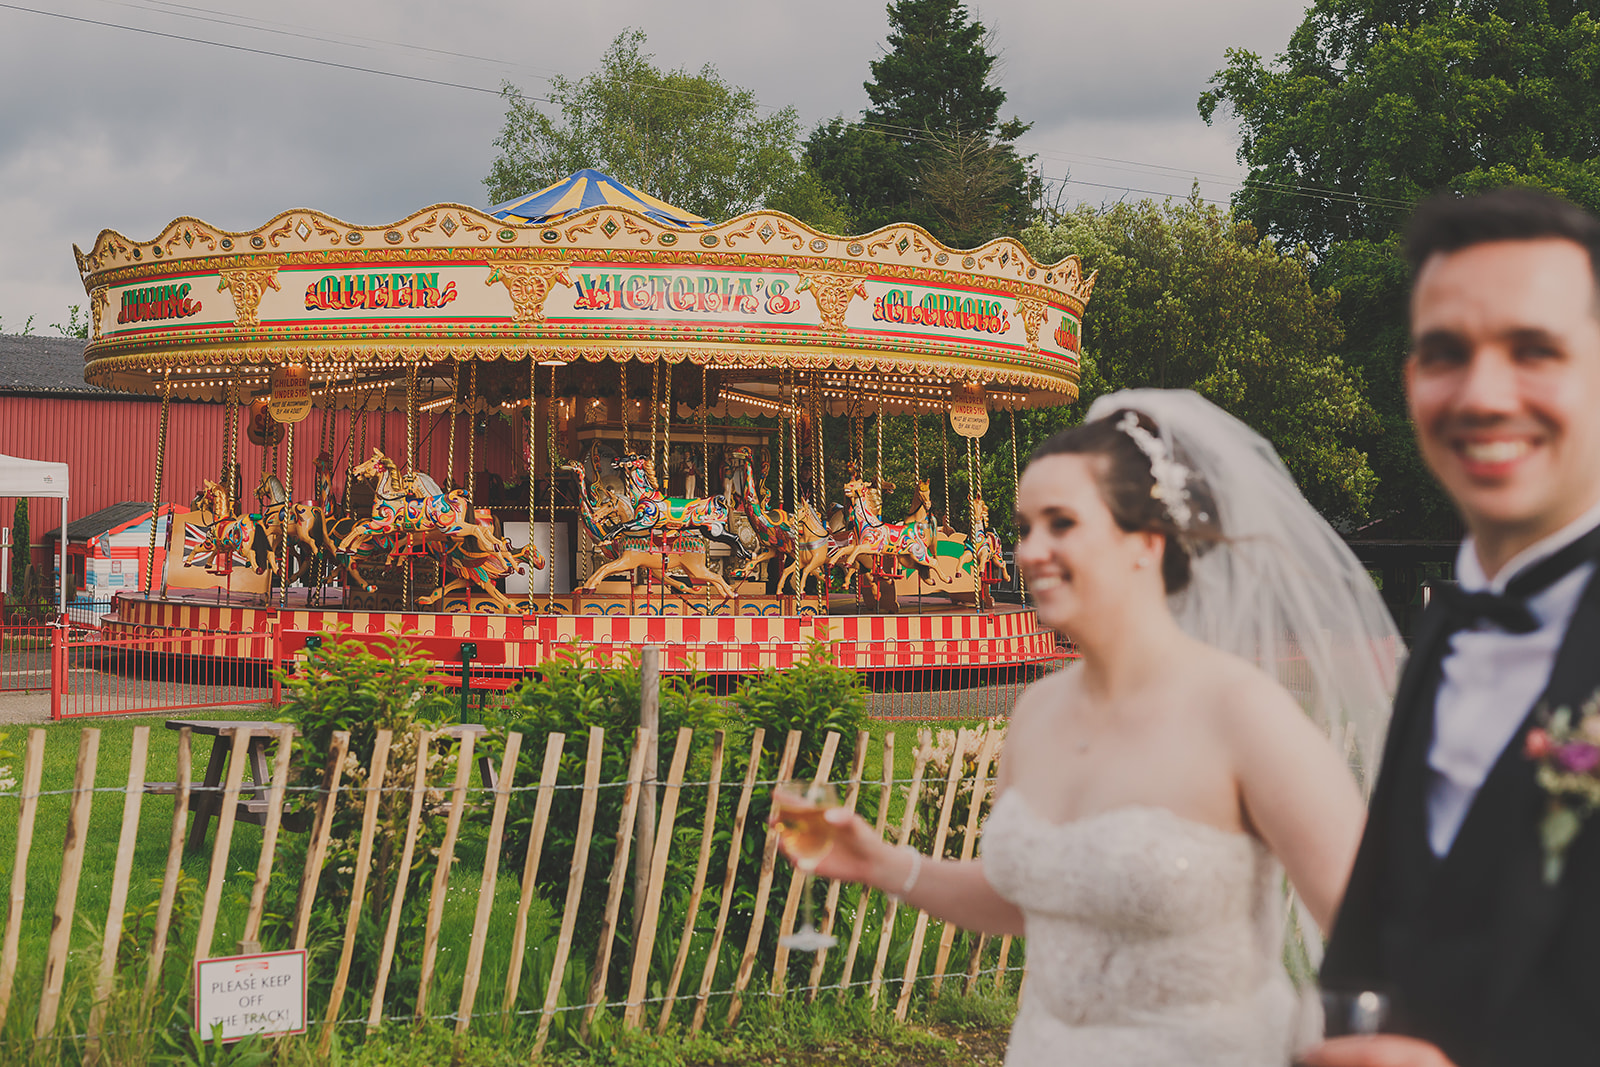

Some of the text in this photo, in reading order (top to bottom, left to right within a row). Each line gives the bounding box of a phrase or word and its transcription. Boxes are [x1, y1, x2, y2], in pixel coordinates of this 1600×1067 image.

[117, 272, 1010, 334] DURING QUEEN VICTORIA'S GLORIOUS
[285, 369, 297, 378] ALL
[274, 378, 307, 388] CHILDREN
[964, 386, 974, 395] ALL
[955, 395, 984, 405] CHILDREN
[211, 974, 292, 994] PLEASE KEEP
[238, 994, 265, 1008] OFF
[213, 1009, 290, 1027] THE TRACK!
